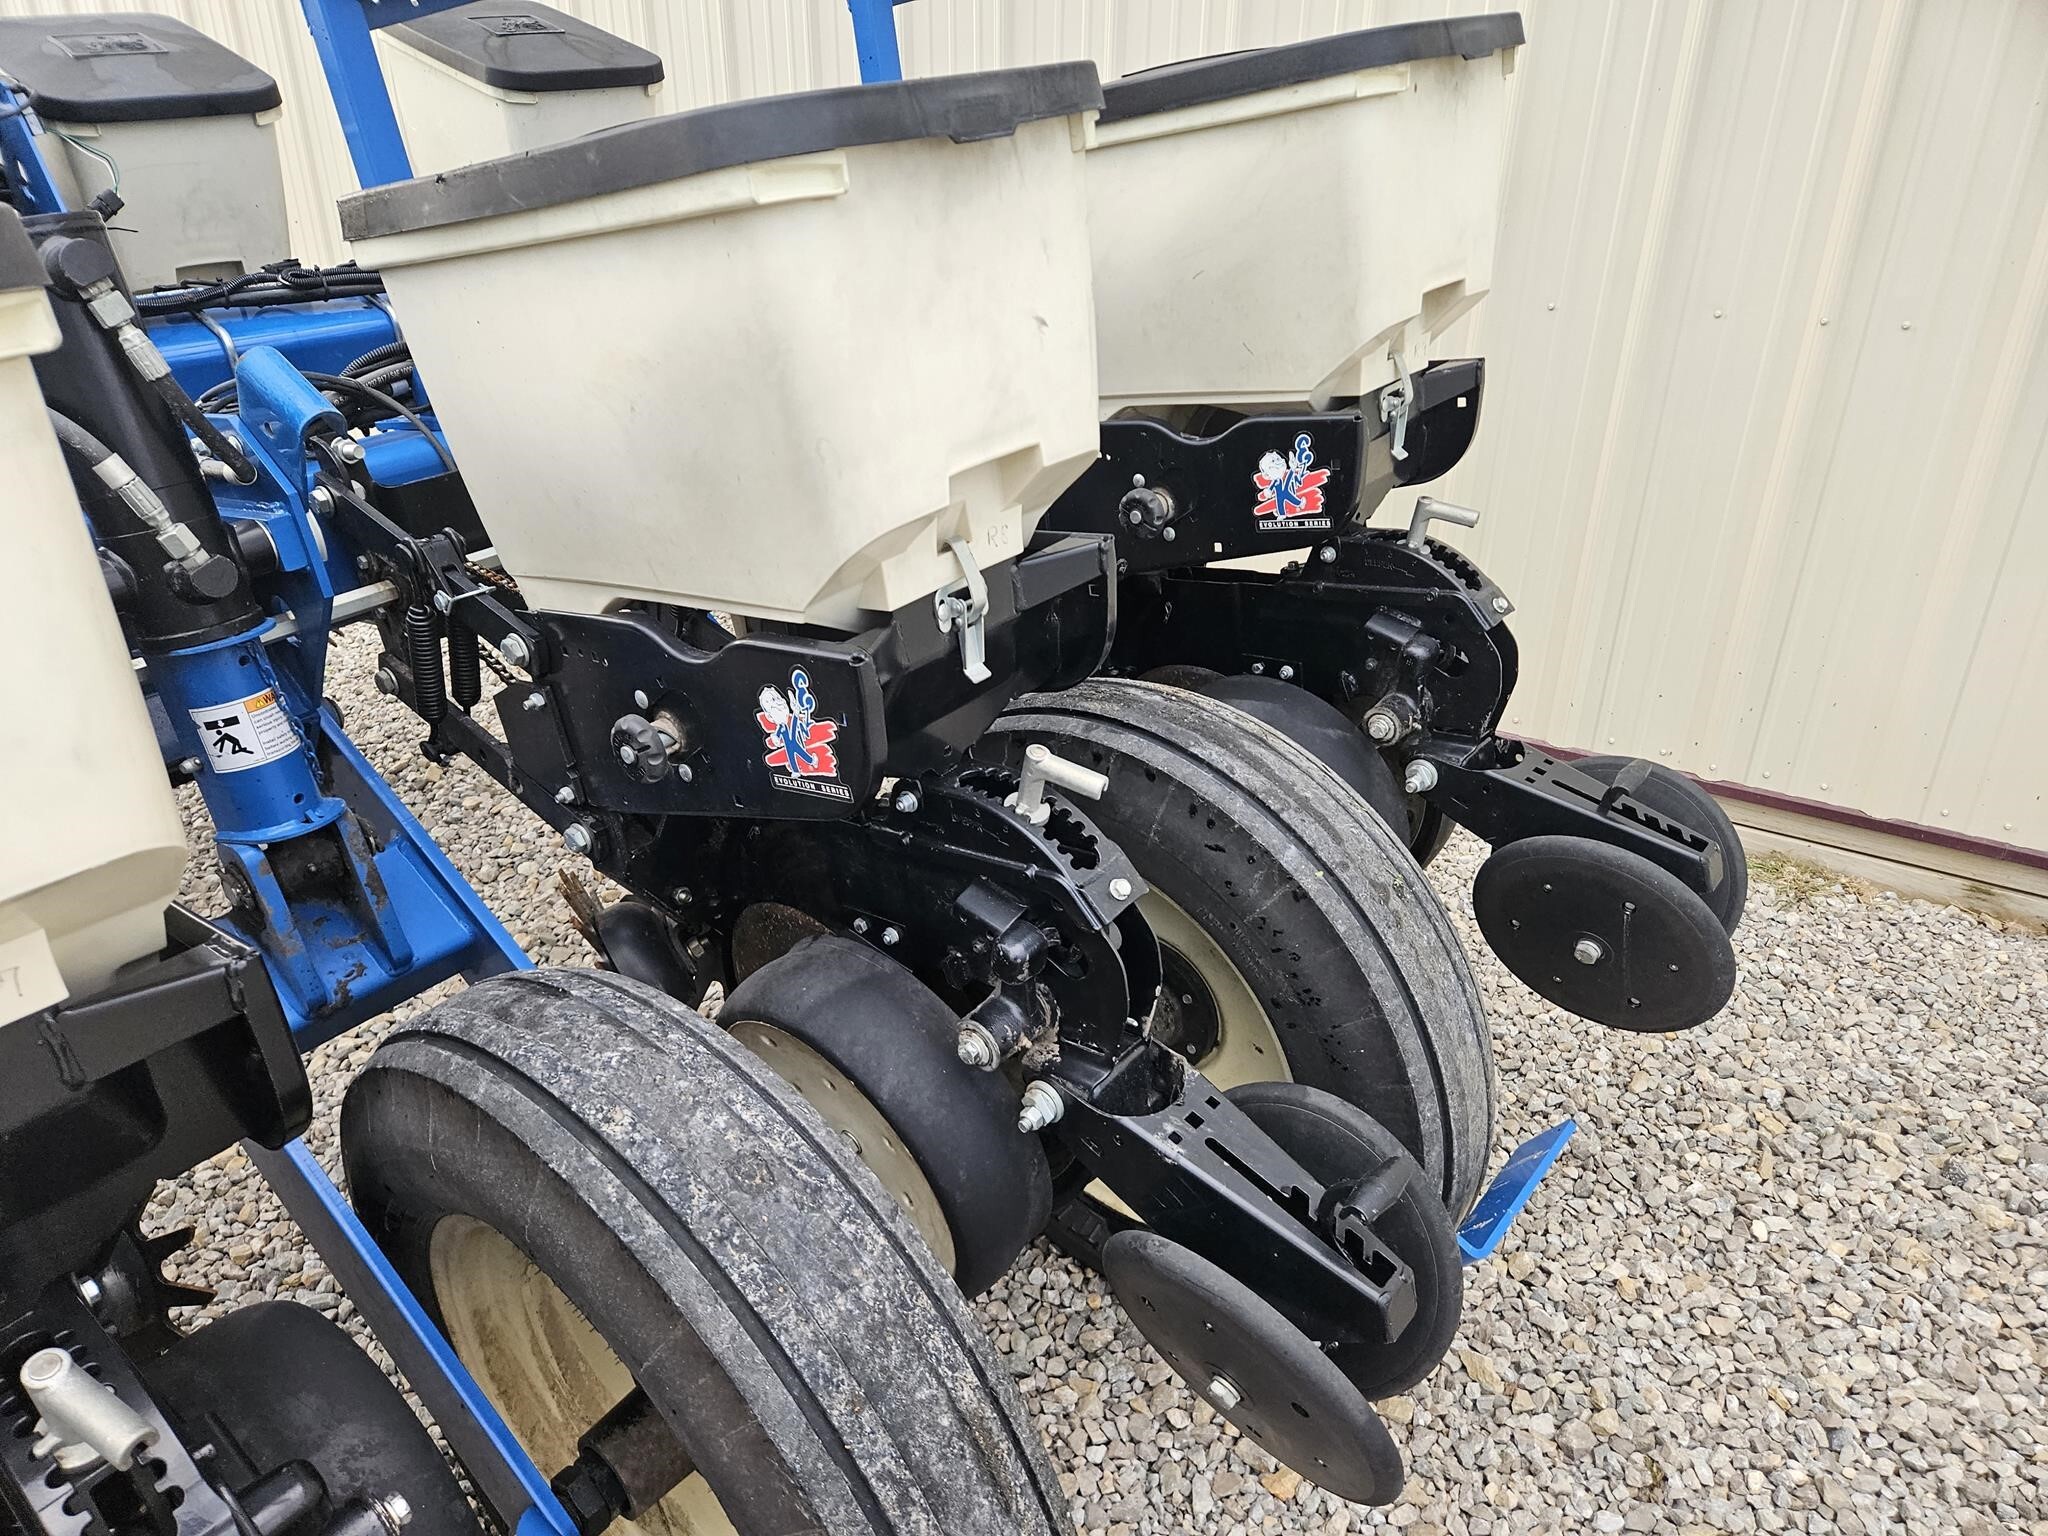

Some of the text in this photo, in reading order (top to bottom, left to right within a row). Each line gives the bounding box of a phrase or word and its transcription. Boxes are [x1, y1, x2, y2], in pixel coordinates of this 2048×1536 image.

[1259, 520, 1331, 528] EVOLUTION SERIES
[774, 776, 850, 798] EVOLUTION SERIES
